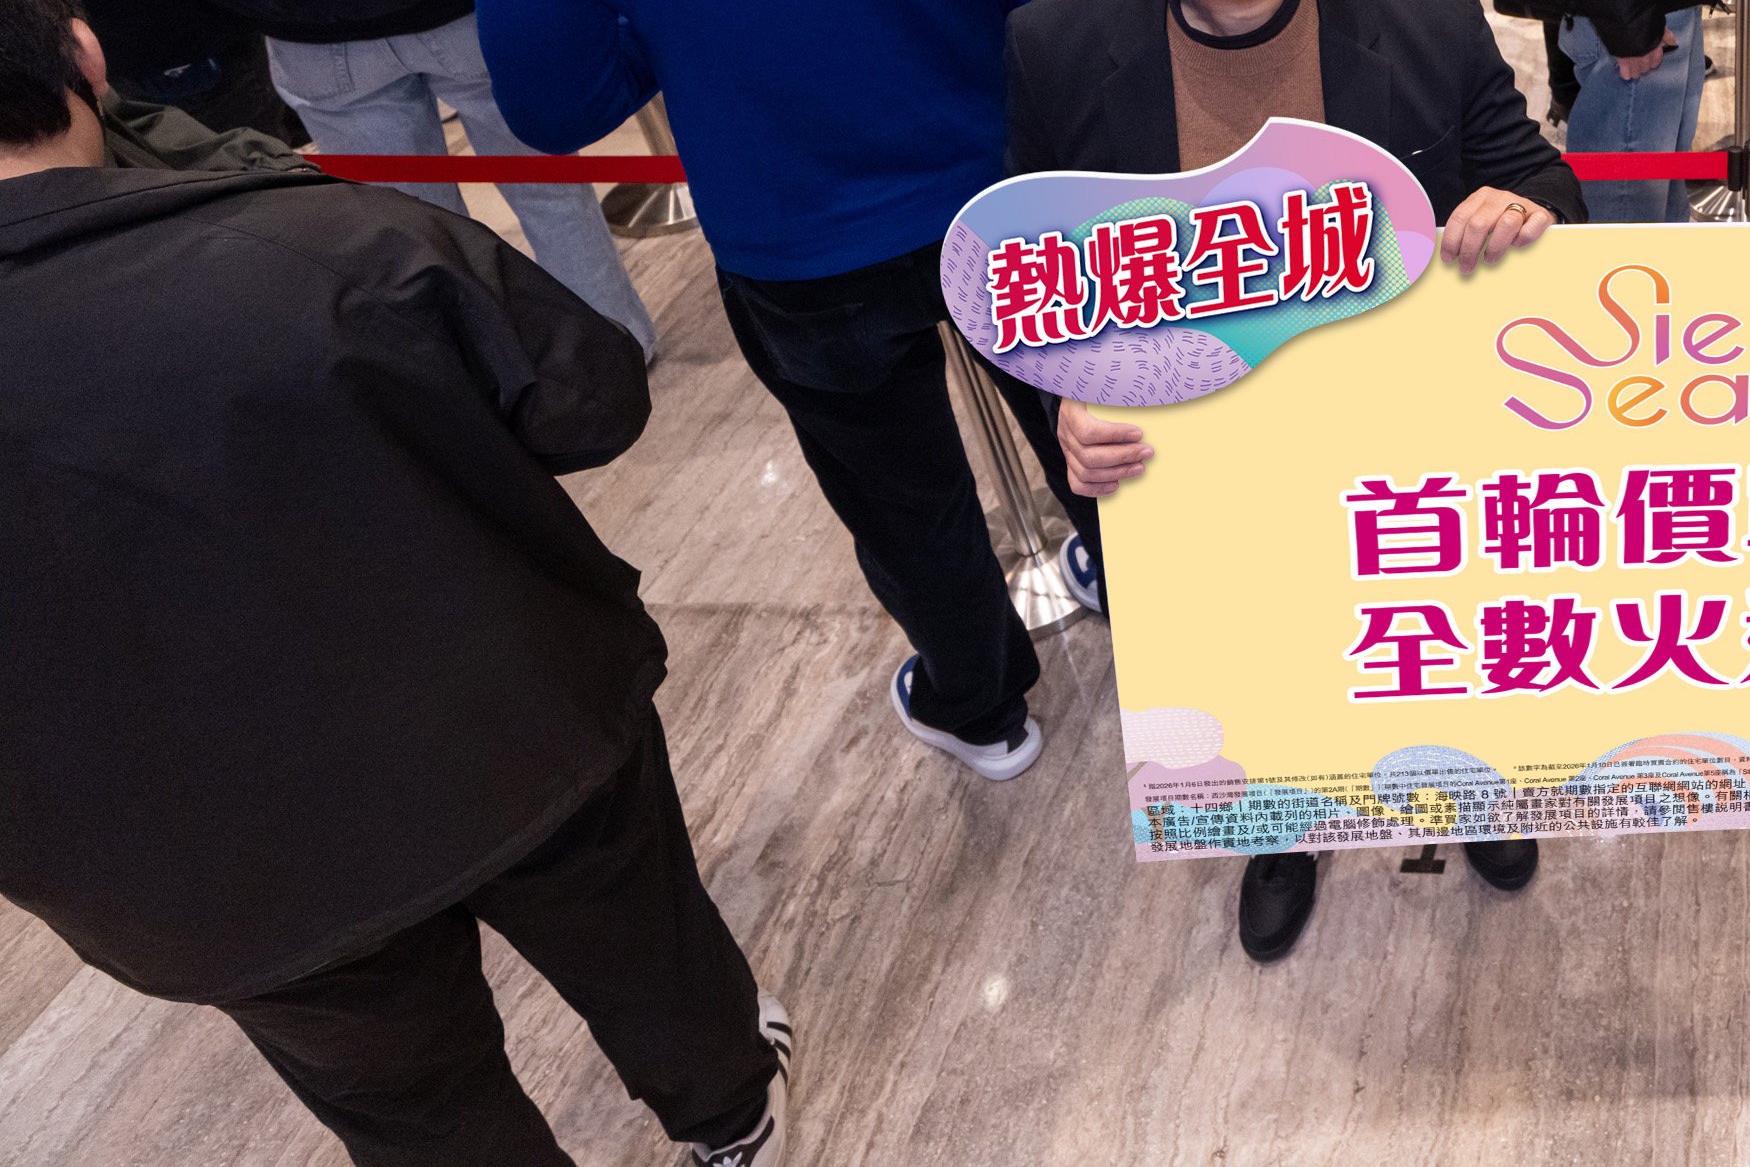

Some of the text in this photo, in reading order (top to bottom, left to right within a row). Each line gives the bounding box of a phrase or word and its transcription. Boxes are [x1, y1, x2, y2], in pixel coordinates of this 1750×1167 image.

[989, 183, 1373, 352] 熱爆全城
[1495, 316, 1750, 431] Sea
